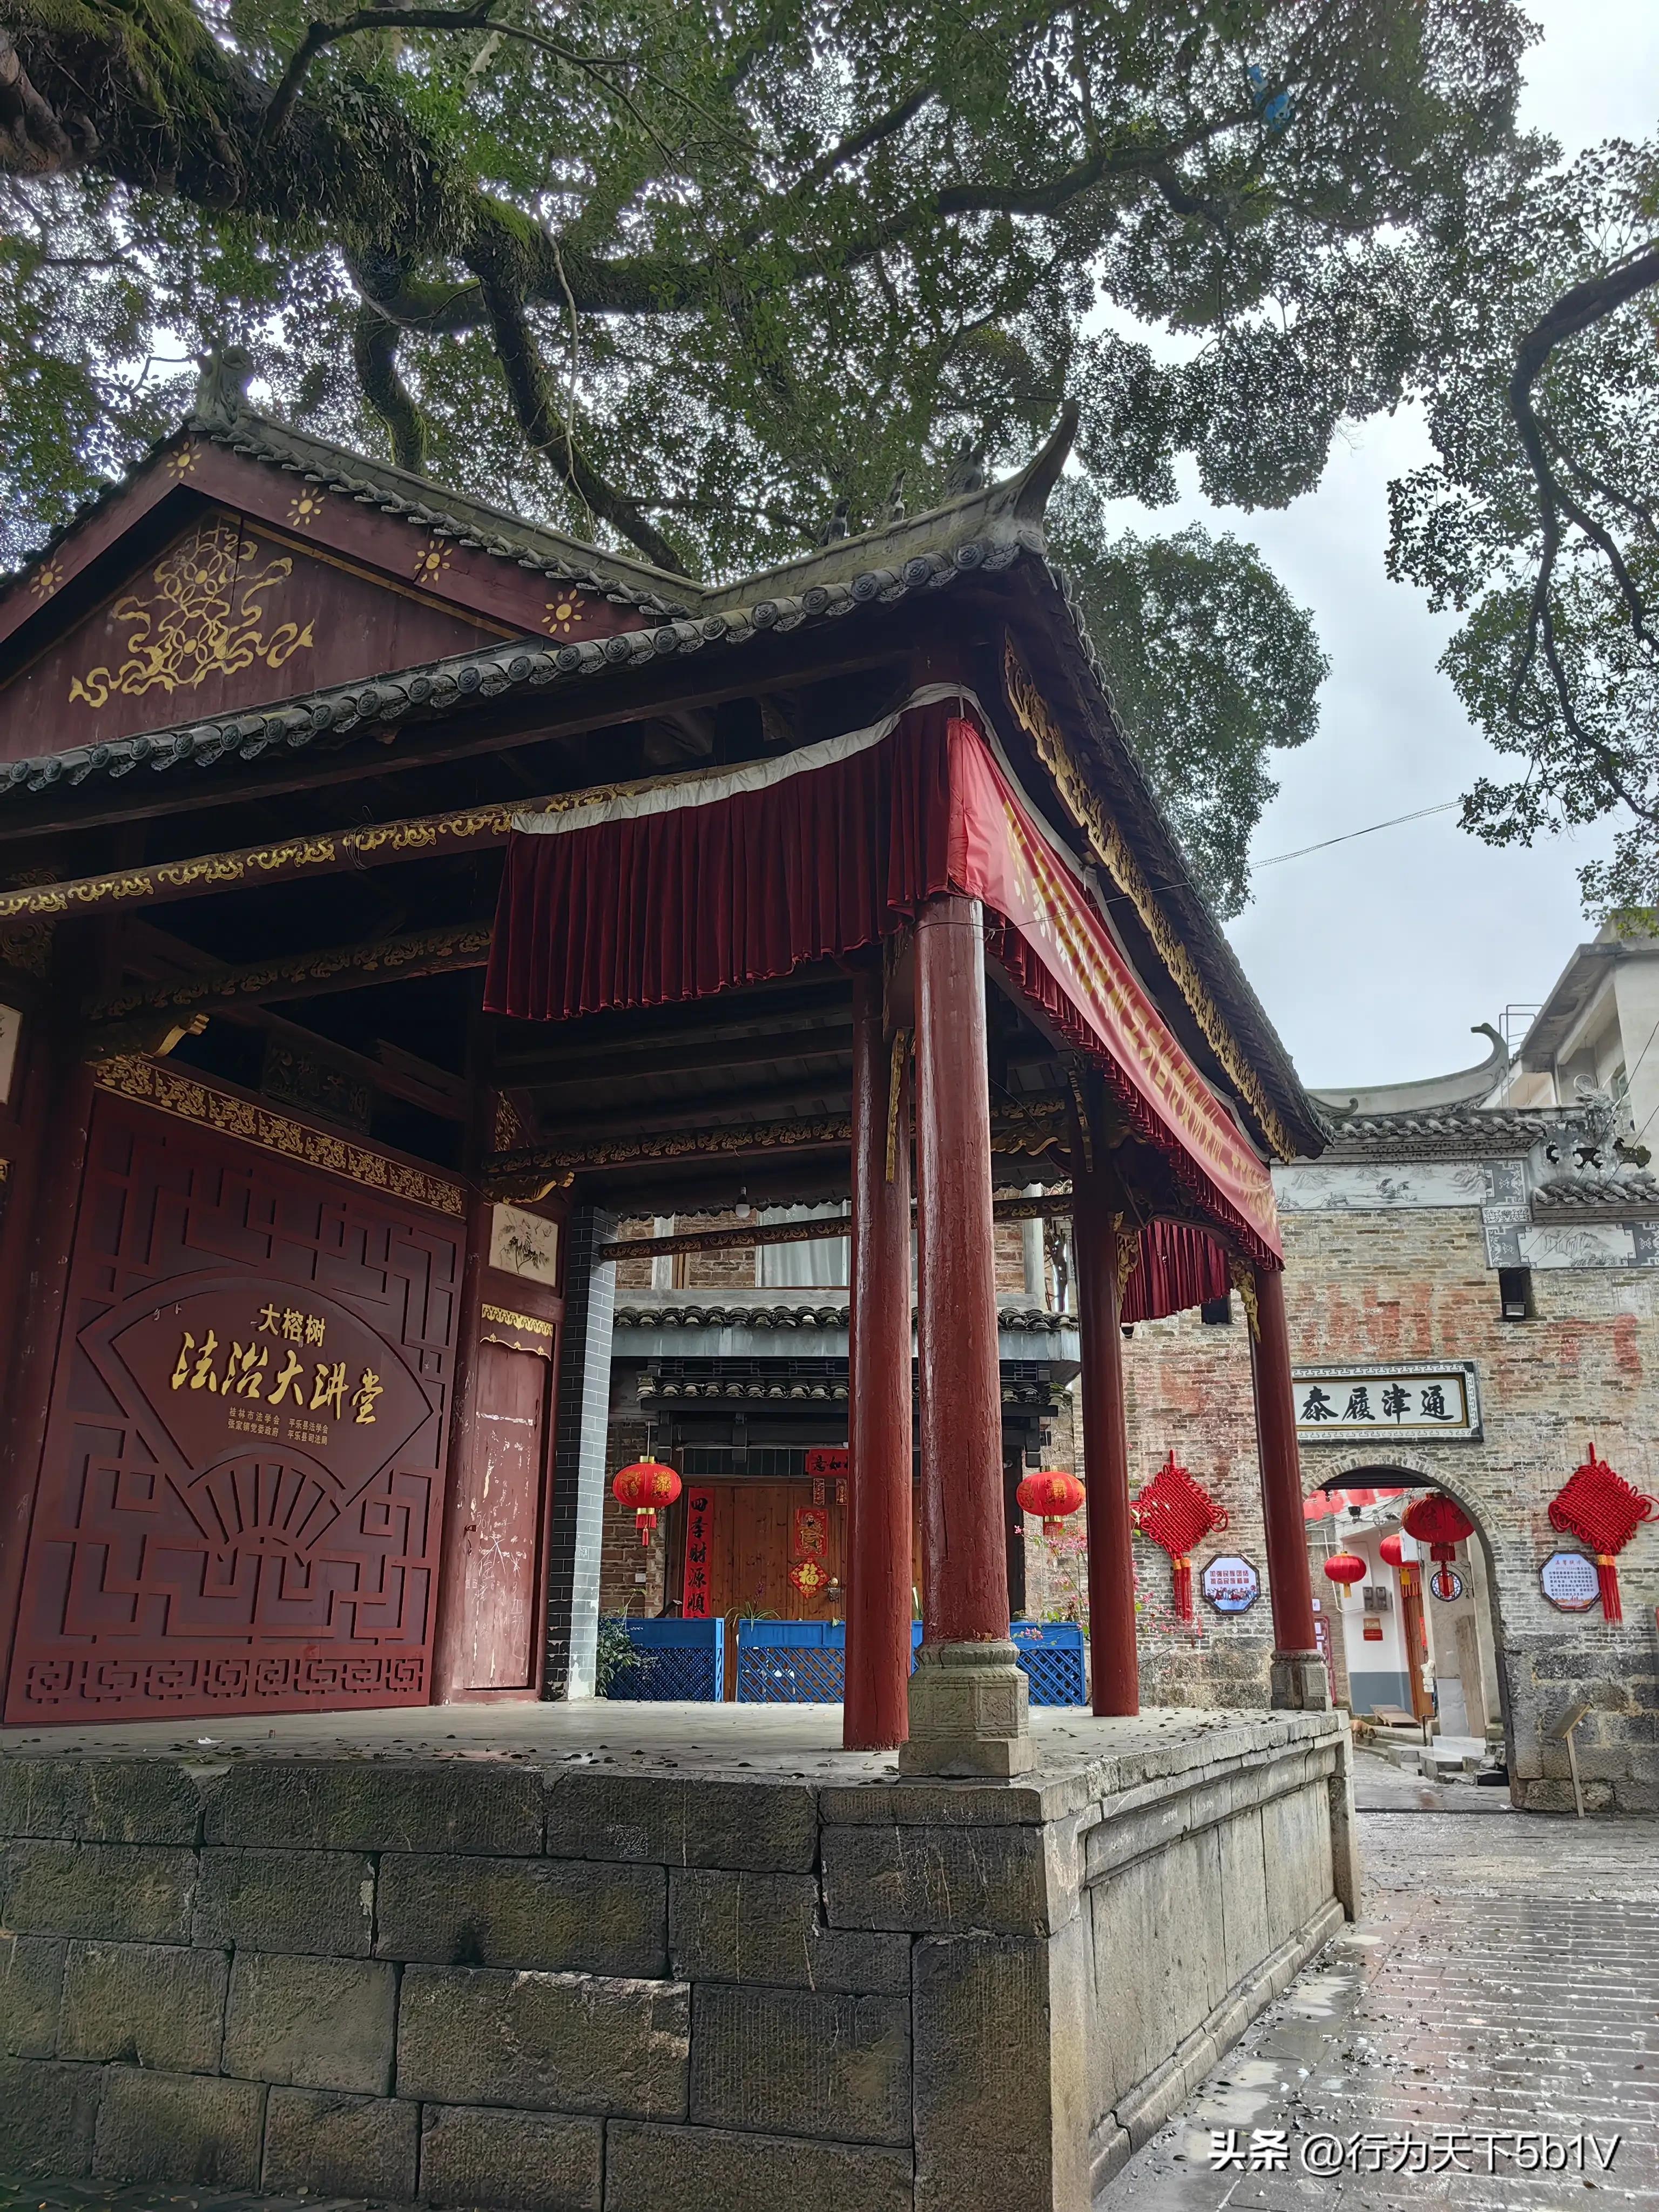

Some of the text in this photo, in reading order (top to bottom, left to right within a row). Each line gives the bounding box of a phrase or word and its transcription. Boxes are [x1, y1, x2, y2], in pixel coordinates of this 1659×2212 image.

[259, 1303, 326, 1347] 大榕树
[171, 1330, 384, 1425] 法治大讲堂
[228, 1419, 328, 1445] 张家镇党委政府 平乐县司法局
[229, 1406, 328, 1434] 桂林市法学会 平乐县法学会
[798, 1563, 819, 1586] 福
